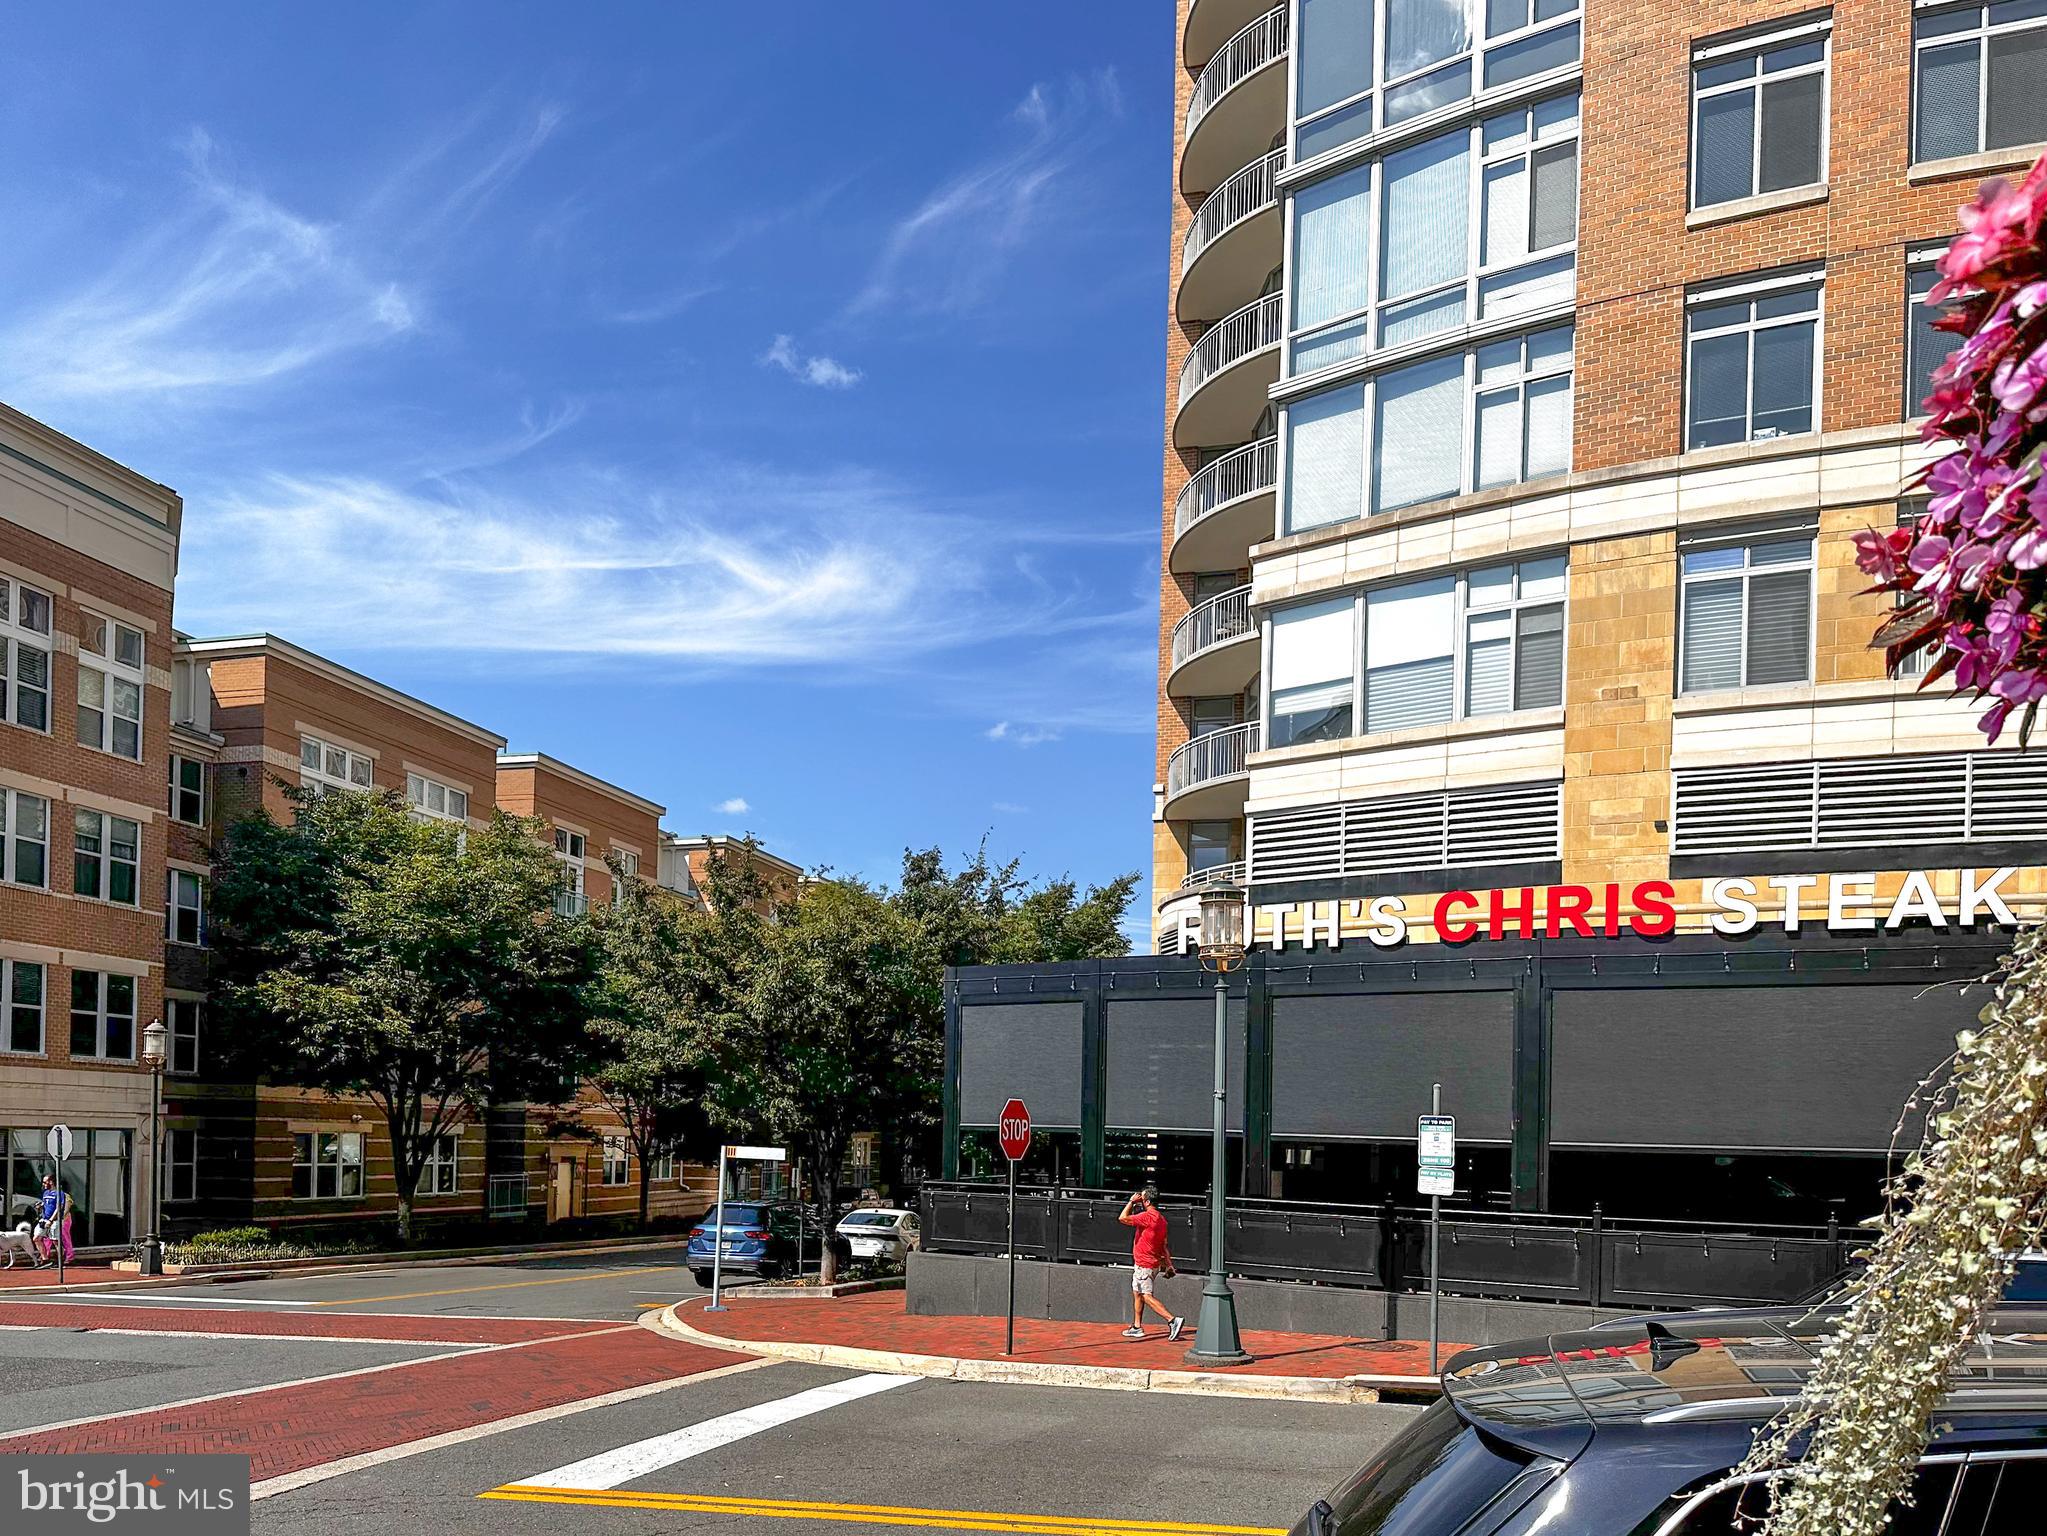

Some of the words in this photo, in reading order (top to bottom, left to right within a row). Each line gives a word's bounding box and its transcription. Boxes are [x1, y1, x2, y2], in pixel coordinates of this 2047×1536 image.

[1177, 895, 1406, 955] RTH'S
[1433, 880, 1677, 943] CHRIS
[1710, 867, 2019, 934] STEAK
[1002, 1118, 1028, 1140] STOP
